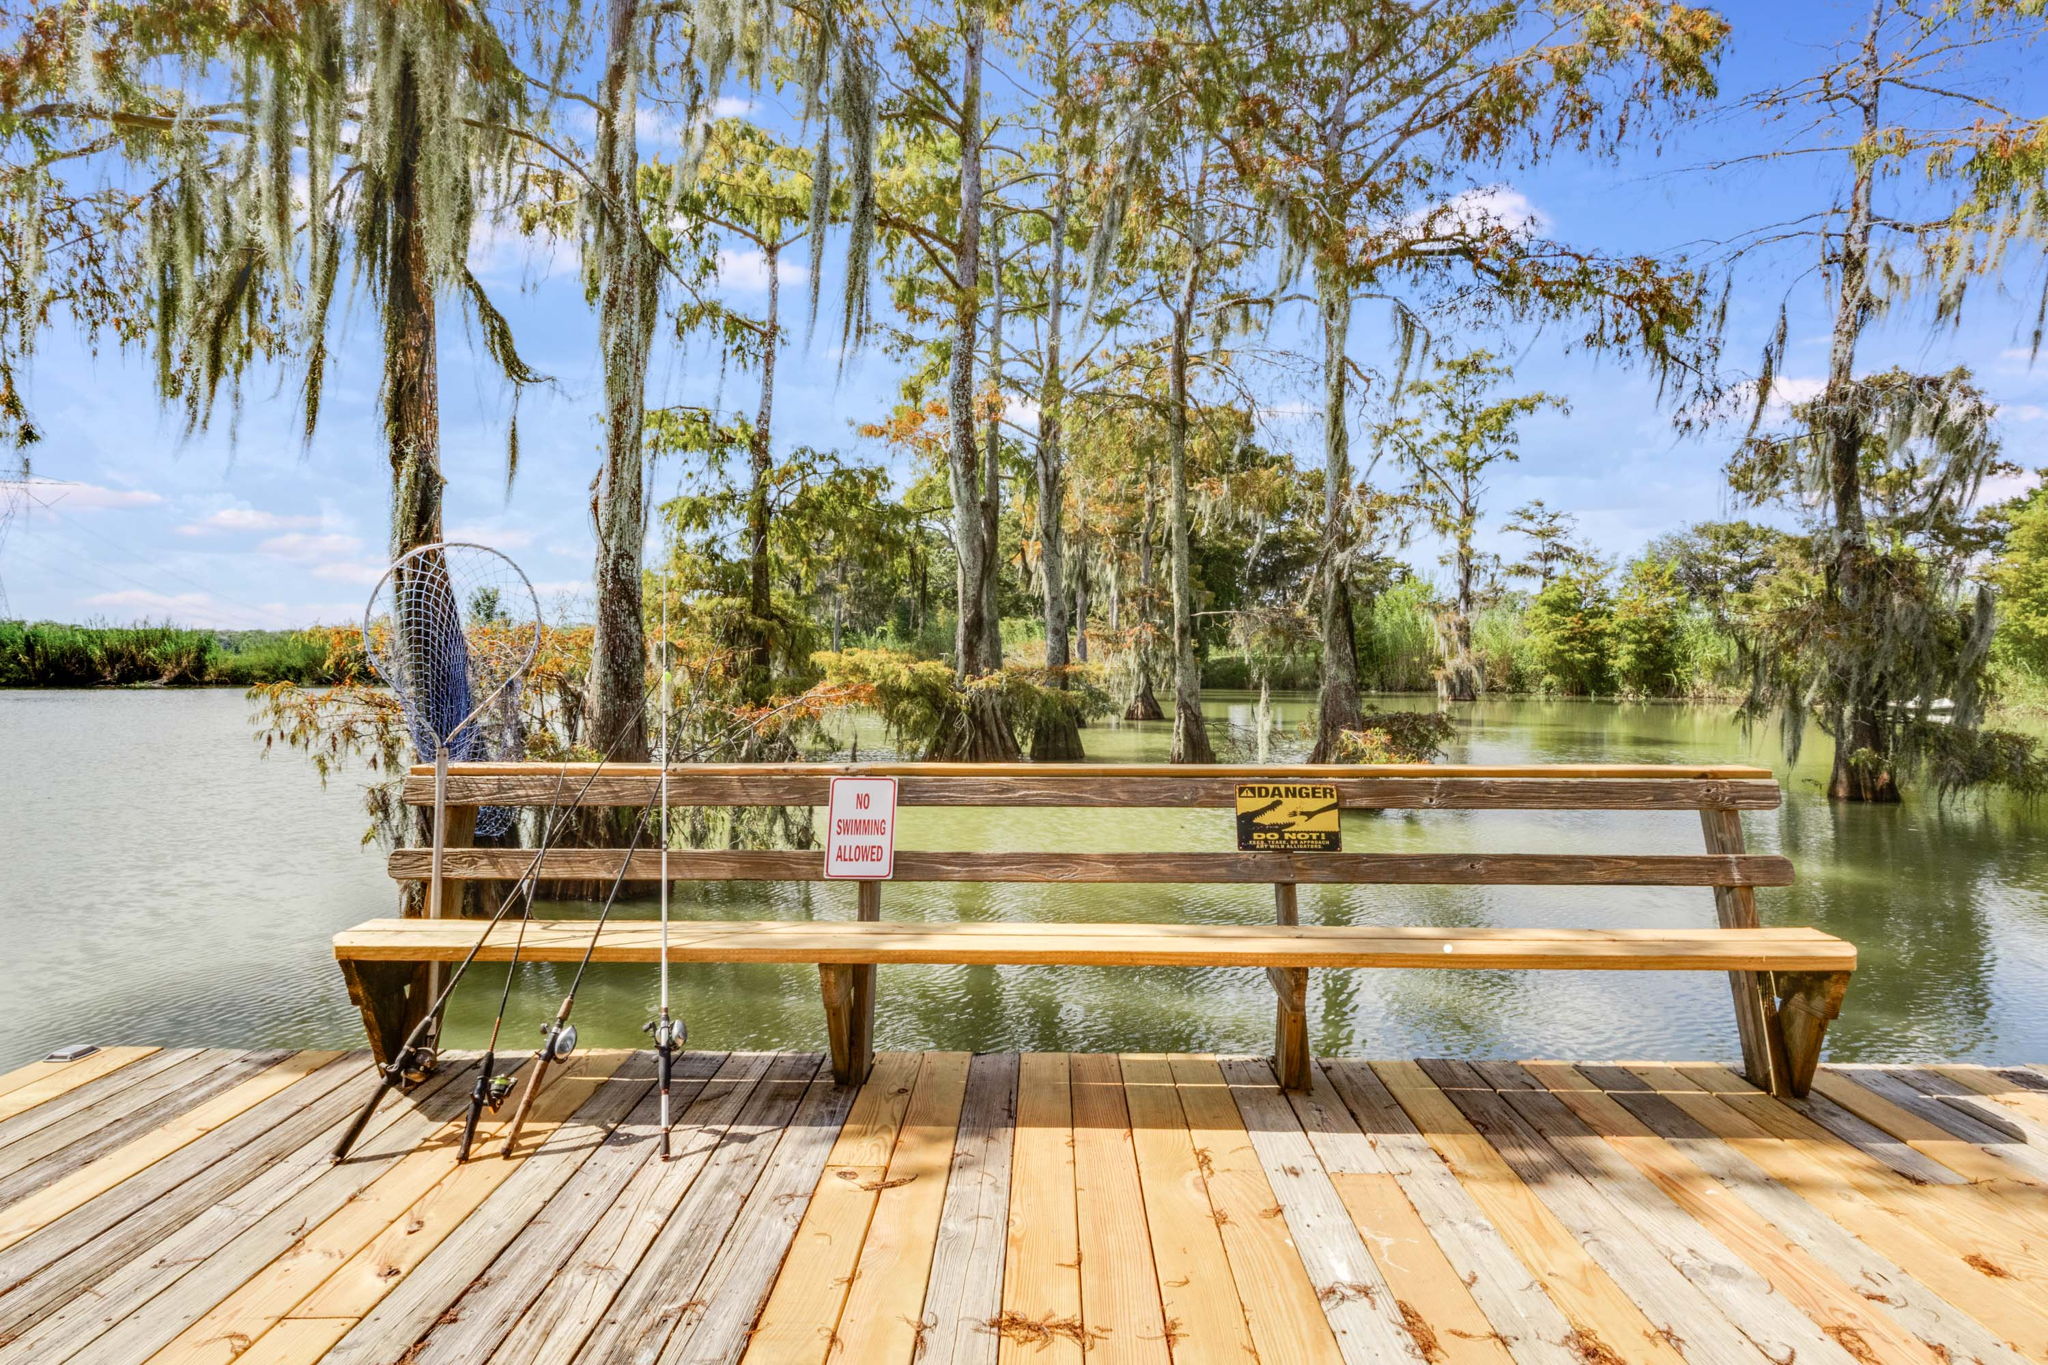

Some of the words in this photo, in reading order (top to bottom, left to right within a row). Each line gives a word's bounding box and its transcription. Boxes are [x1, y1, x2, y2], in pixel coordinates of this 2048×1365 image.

[1257, 786, 1335, 799] DANGER
[856, 793, 870, 810] NO
[836, 819, 886, 836] SWIMMING
[1252, 832, 1279, 840] DO
[1284, 832, 1326, 840] NOT!
[836, 845, 883, 862] ALLOWED
